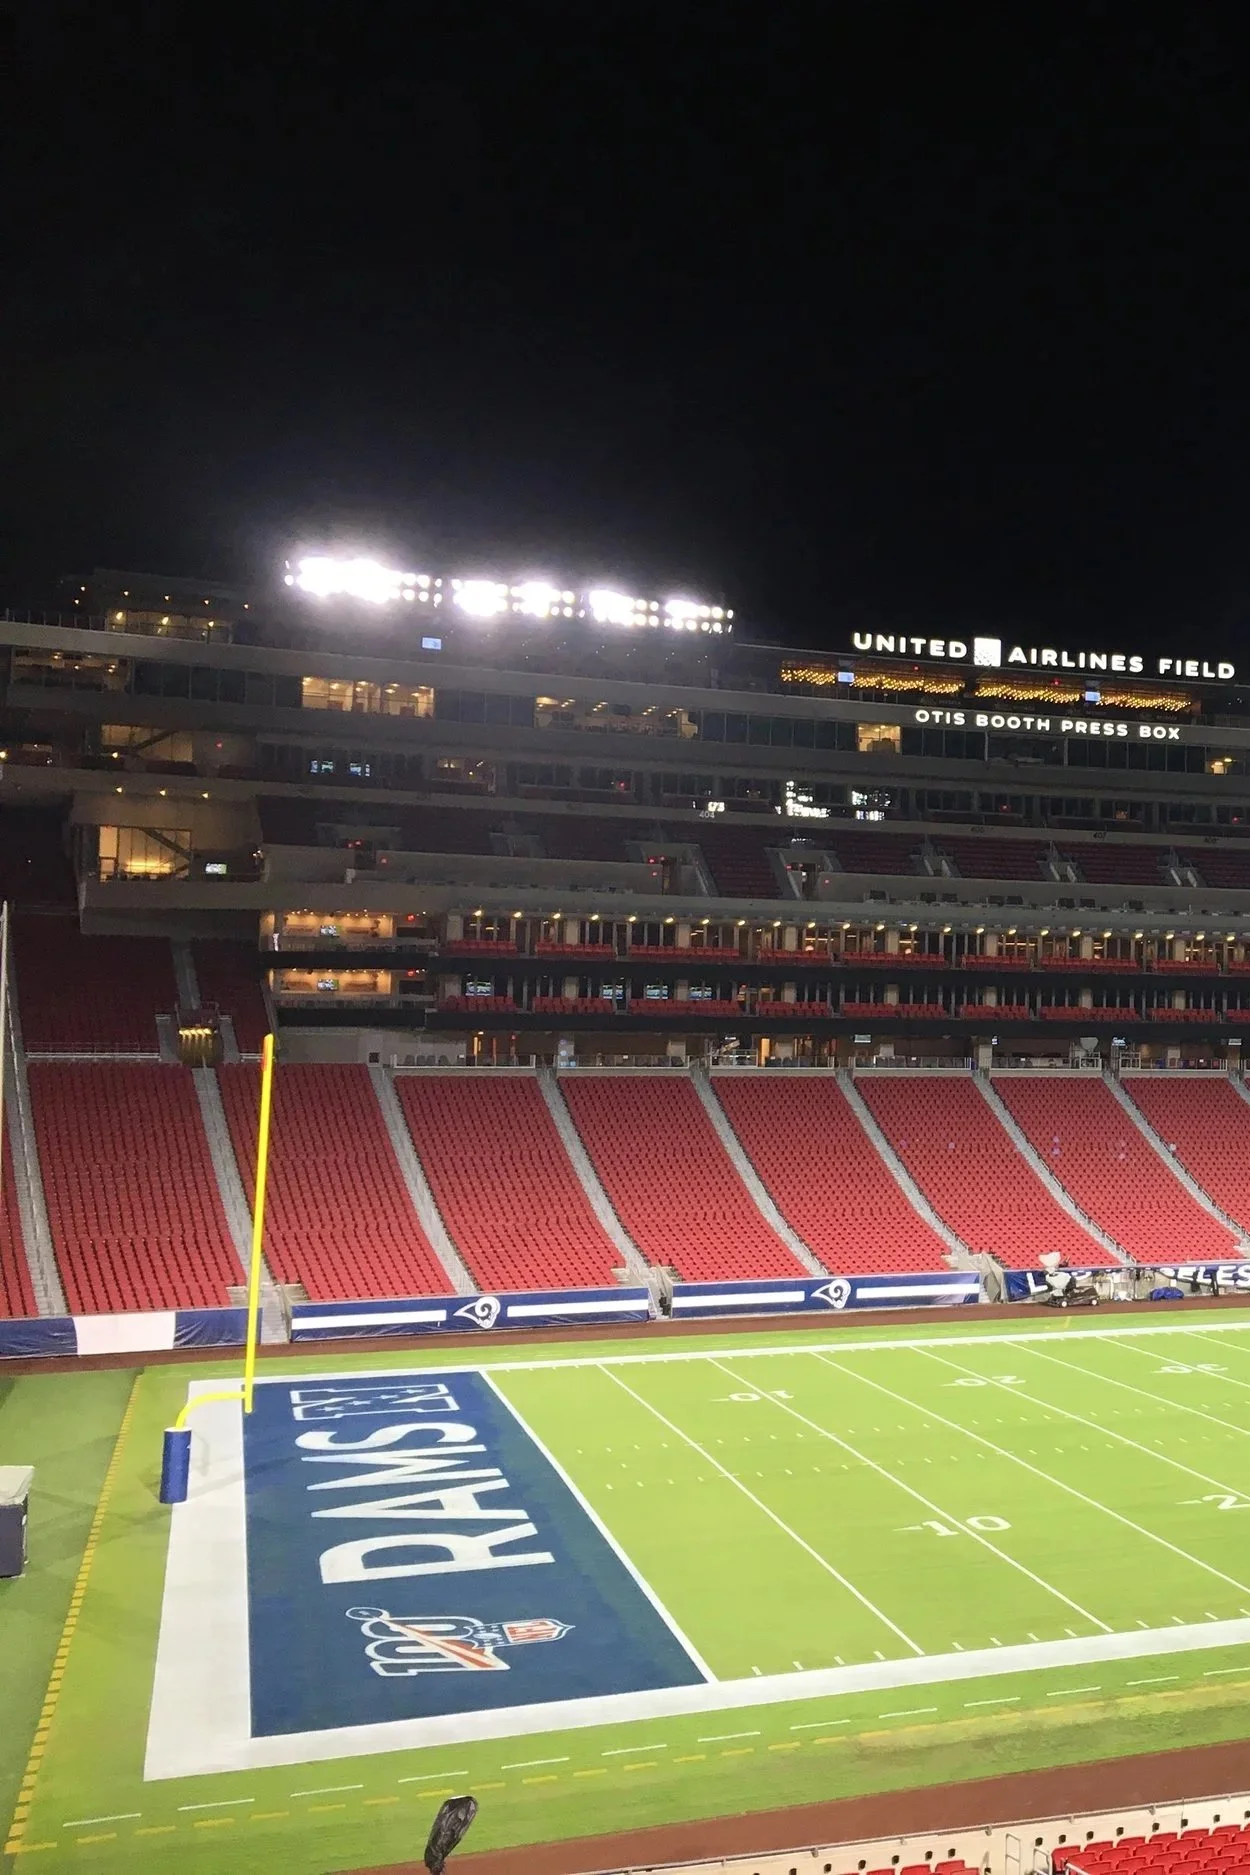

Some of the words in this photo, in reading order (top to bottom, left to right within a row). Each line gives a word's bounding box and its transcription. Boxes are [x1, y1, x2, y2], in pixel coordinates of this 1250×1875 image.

[853, 632, 967, 659] UNITED
[1007, 646, 1144, 673] AIRLINES
[1159, 658, 1235, 679] FIELD
[914, 709, 966, 726] OTIS
[975, 713, 1050, 732] BOOTH
[1060, 719, 1128, 737] PRESS
[1138, 725, 1180, 740] BOX
[294, 1421, 556, 1584] RAMS
[922, 1515, 1012, 1537] 10
